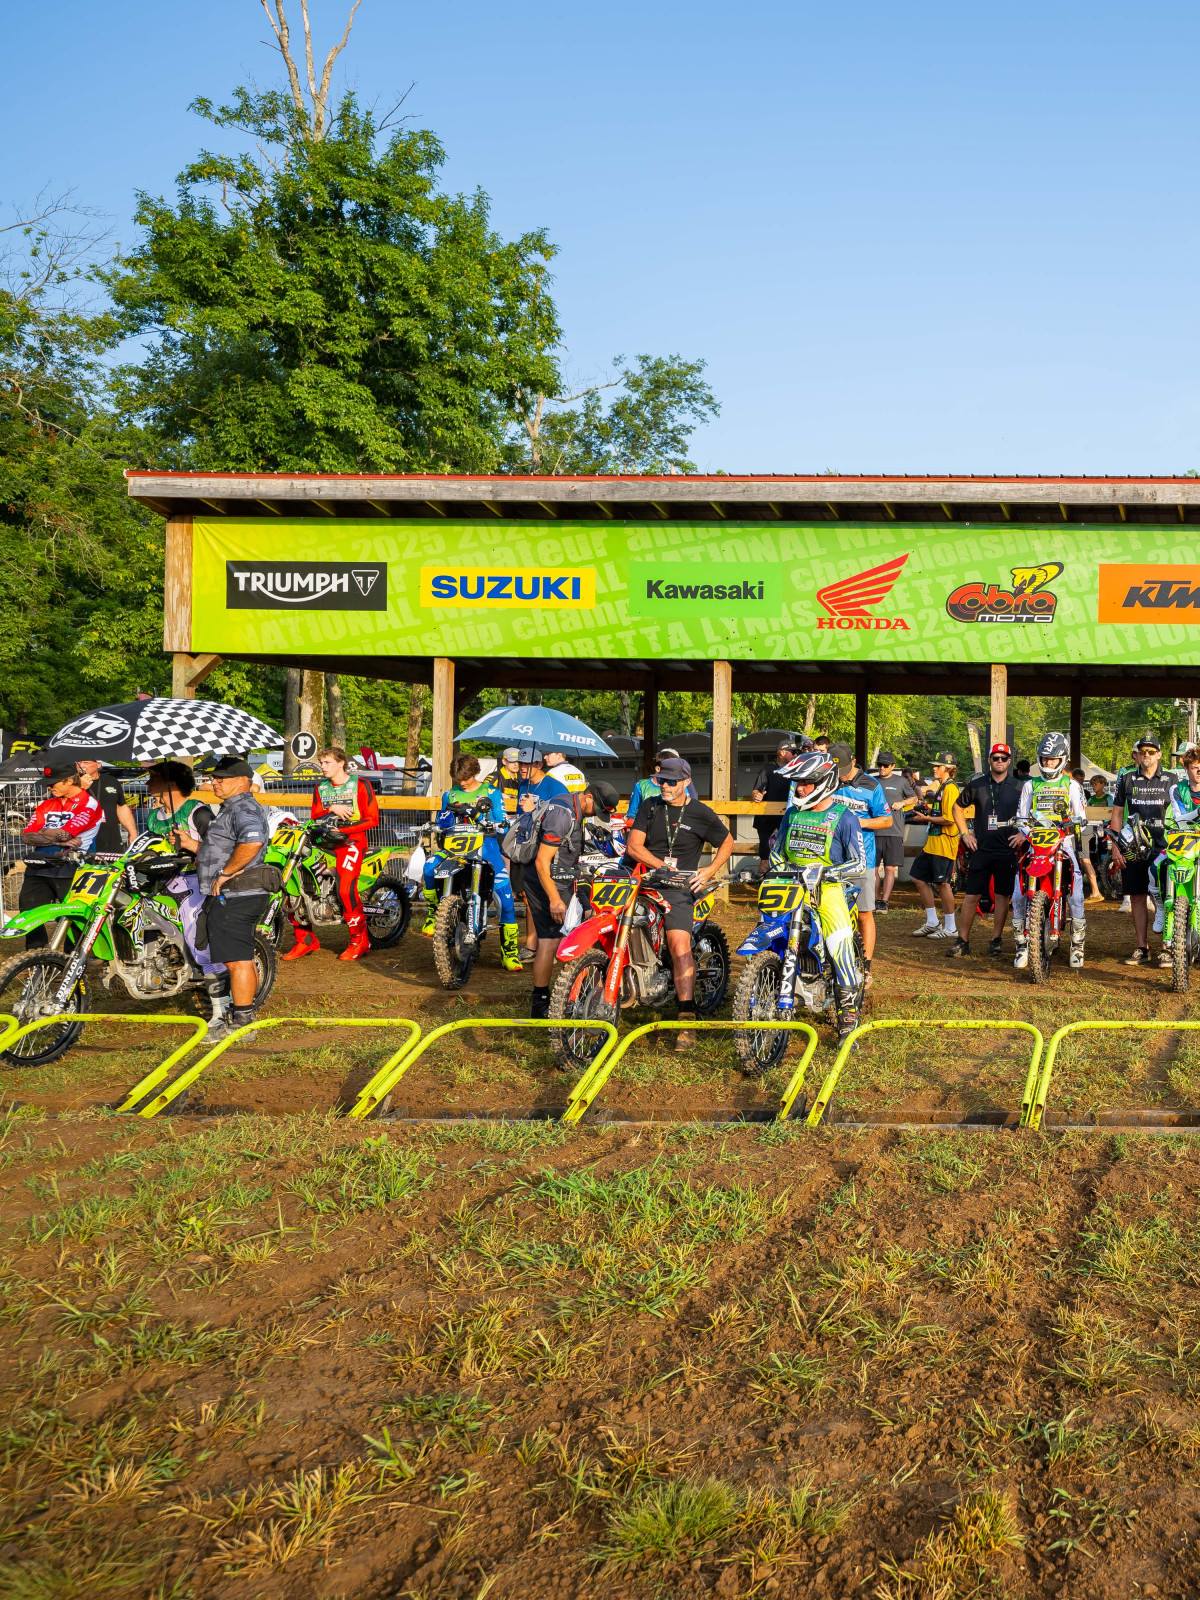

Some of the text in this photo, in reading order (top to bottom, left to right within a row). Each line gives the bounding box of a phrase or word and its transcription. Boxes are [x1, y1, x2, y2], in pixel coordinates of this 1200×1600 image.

[351, 527, 446, 565] 2025
[233, 571, 350, 603] TRIUMPH
[431, 575, 581, 600] SUZUKI
[646, 580, 764, 600] Kawasaki
[946, 582, 1058, 622] Cobra
[816, 617, 911, 630] HONDA
[977, 614, 1053, 623] MOTO
[297, 735, 312, 757] P
[557, 731, 597, 747] THOR
[1131, 798, 1166, 806] Kawasaki
[273, 830, 295, 847] 71
[449, 836, 480, 854] 31
[1032, 831, 1061, 846] 52
[1168, 834, 1200, 852] 47
[341, 844, 360, 872] FLY
[367, 858, 384, 875] 71
[70, 871, 111, 896] 41
[126, 864, 140, 890] OAKLEY
[591, 885, 635, 907] 40
[758, 885, 801, 910] 51
[695, 900, 711, 920] 40
[609, 956, 622, 992] DUNLOP
